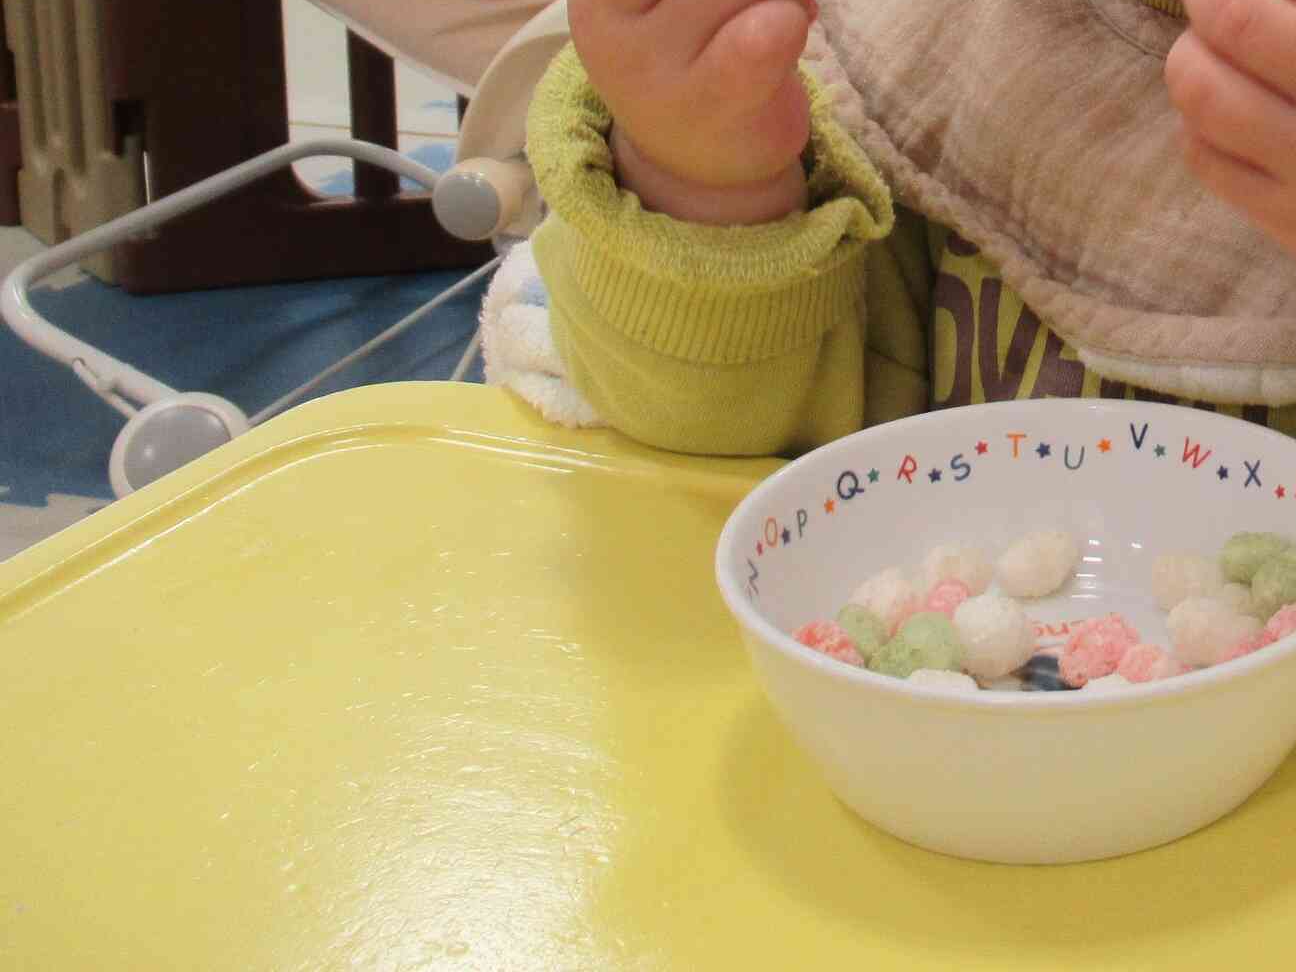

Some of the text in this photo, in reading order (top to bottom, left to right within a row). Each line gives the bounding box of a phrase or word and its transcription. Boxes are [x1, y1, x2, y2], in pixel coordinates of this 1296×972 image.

[764, 517, 778, 548] O
[796, 508, 808, 538] P
[837, 470, 865, 500] Q
[897, 455, 918, 484] R
[950, 454, 971, 481] S
[1006, 432, 1027, 458] T
[1064, 445, 1085, 470] U
[1130, 423, 1148, 450] V
[1182, 436, 1213, 469] W
[1243, 460, 1262, 488] X
